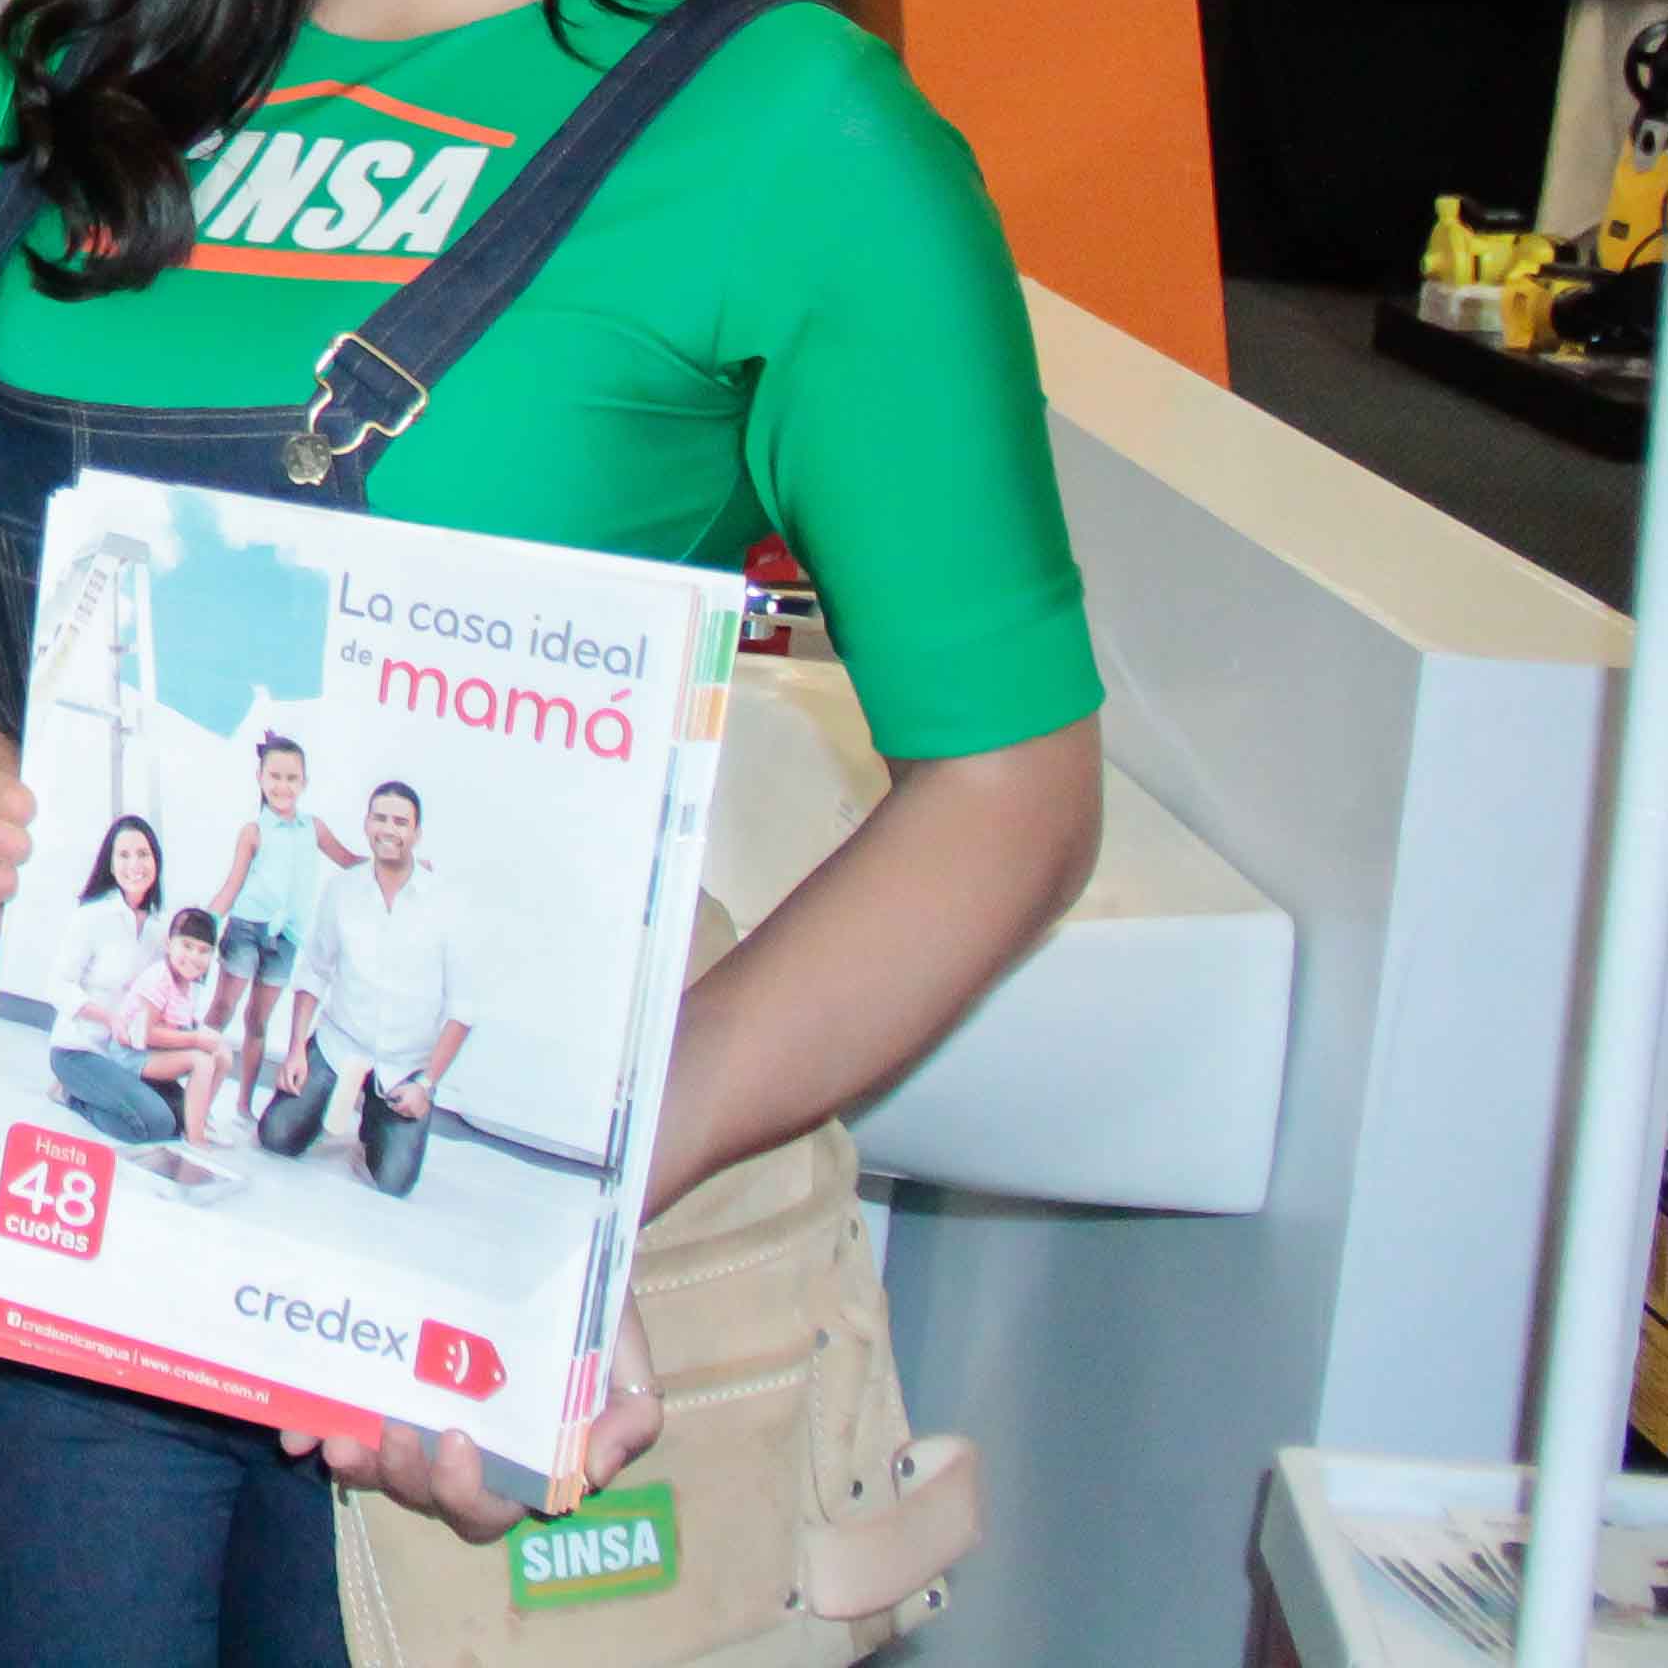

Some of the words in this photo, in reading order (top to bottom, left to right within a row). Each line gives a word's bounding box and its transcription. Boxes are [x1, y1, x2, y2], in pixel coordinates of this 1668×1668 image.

[186, 129, 490, 254] INSA
[339, 571, 394, 623] La
[408, 601, 514, 652] casa
[530, 613, 648, 679] ideal
[340, 639, 373, 665] de
[377, 656, 634, 762] mamá
[35, 1136, 88, 1166] Hasta
[8, 1160, 97, 1228] 48
[5, 1214, 90, 1253] cuotas
[233, 1284, 410, 1362] credex
[521, 1518, 662, 1582] SINSA
